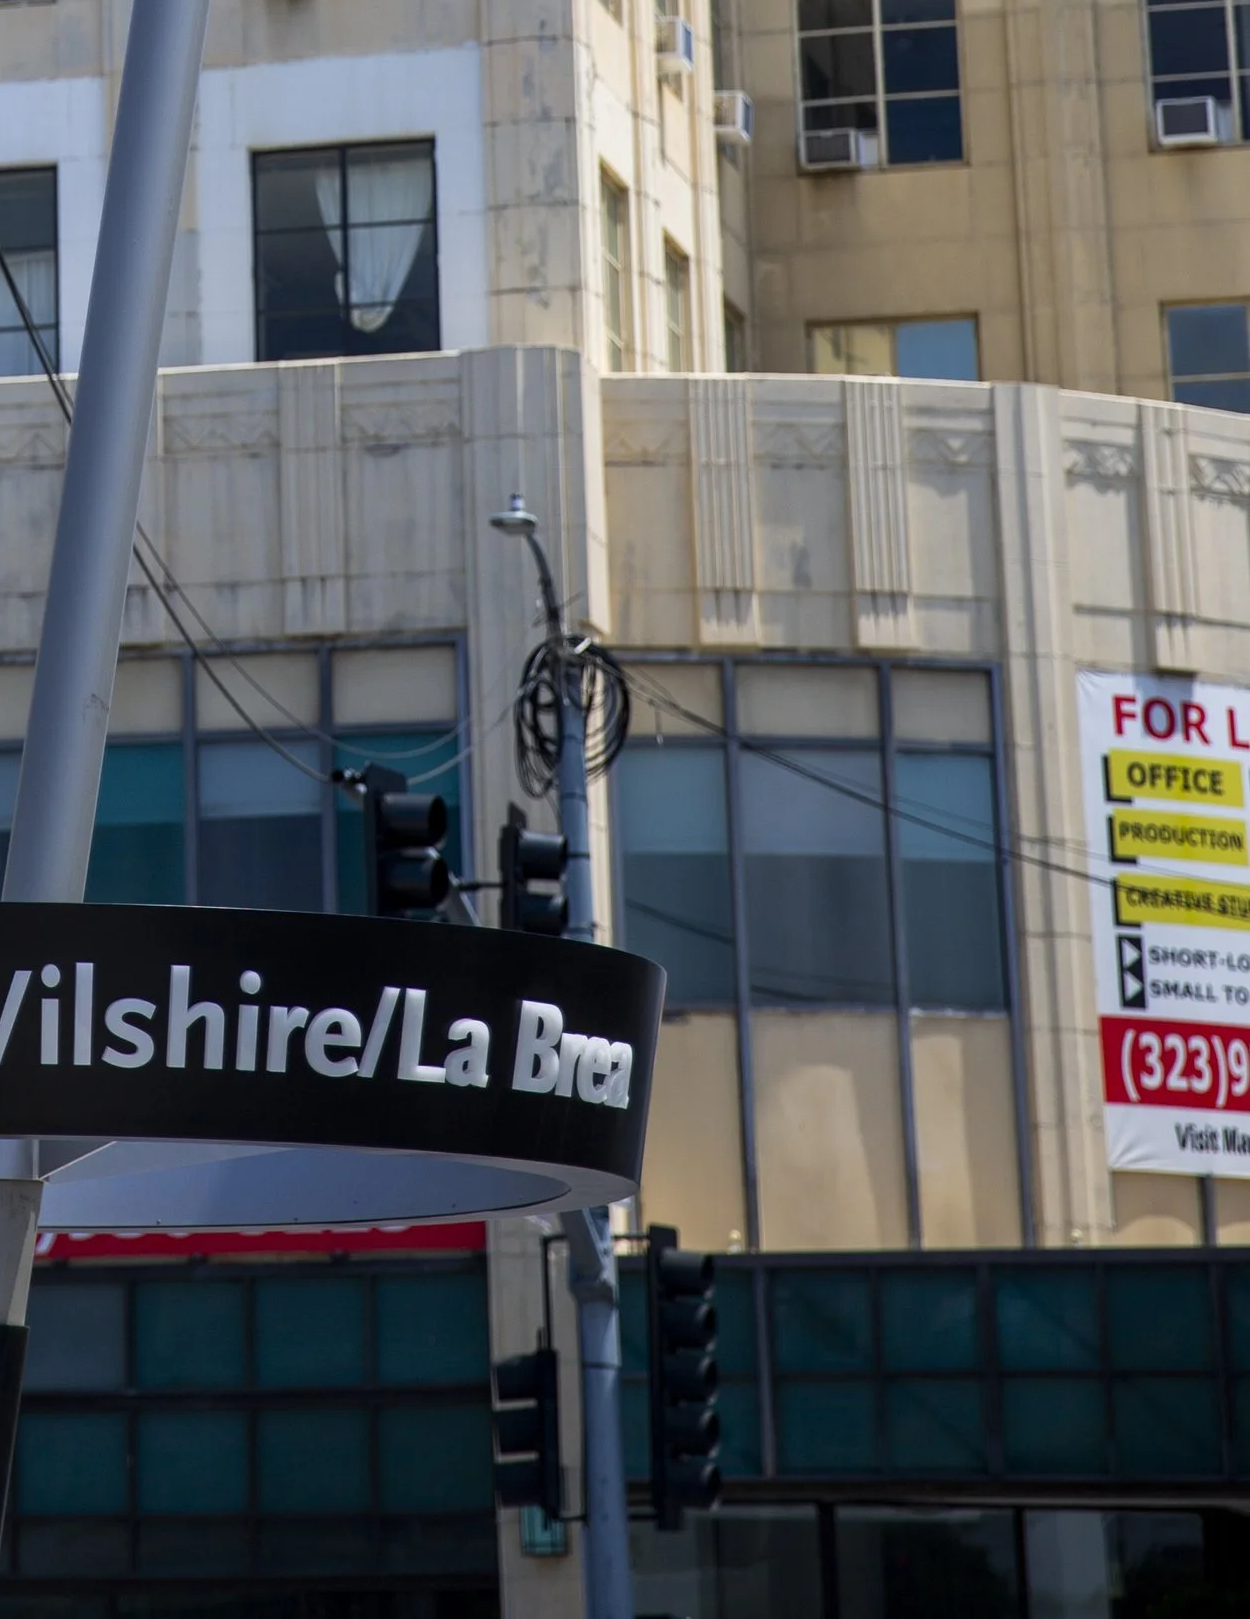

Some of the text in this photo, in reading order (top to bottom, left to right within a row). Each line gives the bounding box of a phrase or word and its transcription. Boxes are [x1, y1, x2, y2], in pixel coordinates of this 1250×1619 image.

[1112, 694, 1211, 746] FOR
[1126, 762, 1224, 796] OFFICE
[1118, 820, 1243, 851] PRODUCTION
[1149, 979, 1218, 1003] SMALL
[512, 999, 633, 1110] Brea
[1174, 1122, 1218, 1153] Visit
